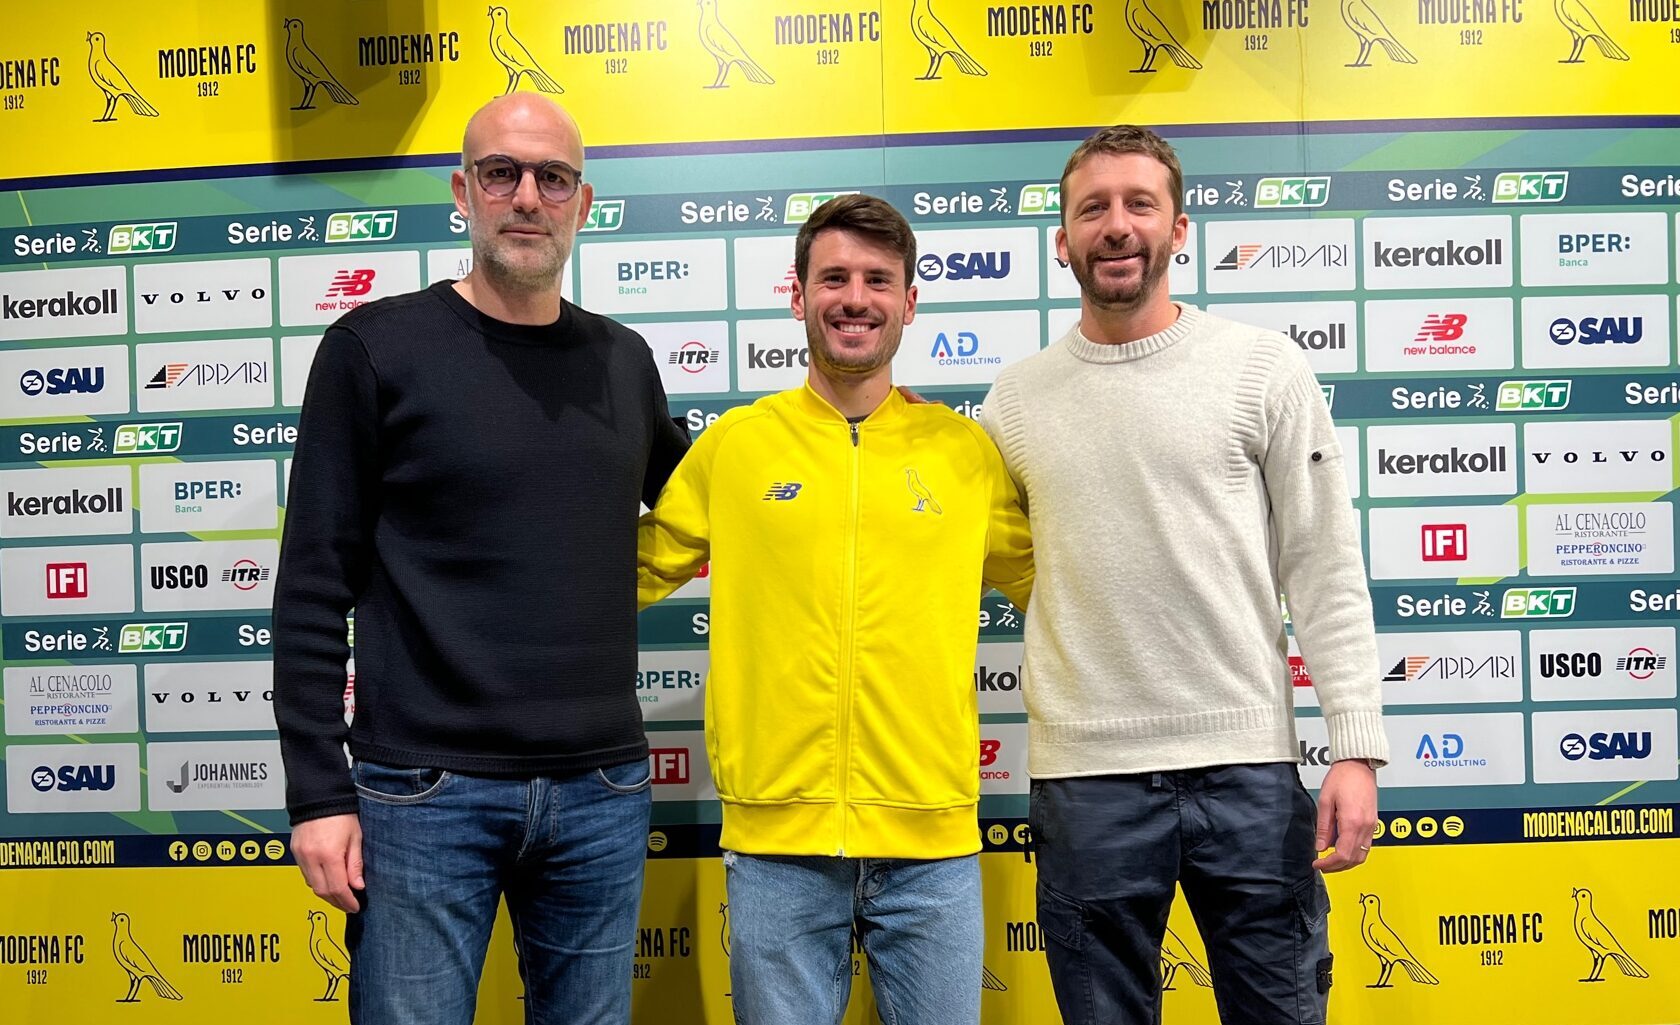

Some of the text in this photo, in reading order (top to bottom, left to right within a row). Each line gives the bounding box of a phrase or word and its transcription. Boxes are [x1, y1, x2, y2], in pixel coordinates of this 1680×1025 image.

[988, 3, 1093, 37] MODENA FC
[1203, 0, 1308, 30] MODENA FC
[1418, 0, 1522, 24] MODENA FC
[1630, 0, 1680, 22] MODE
[564, 21, 667, 54] MODENA FC
[775, 11, 879, 45] MODENA FC
[1460, 29, 1483, 46] 1912
[358, 31, 459, 66] MODENA FC
[1029, 41, 1053, 57] 1912
[1245, 35, 1268, 51] 1912
[158, 44, 256, 78] MODENA FC
[605, 58, 628, 74] 1912
[816, 49, 839, 65] 1912
[0, 57, 60, 88] DENA FC
[398, 69, 421, 85] 1912
[197, 81, 219, 97] 1912
[4, 94, 24, 110] 1912
[913, 185, 1060, 215] Serie BK
[1185, 182, 1326, 206] rie BKT
[1387, 177, 1564, 202] Serie BKT
[680, 201, 749, 224] Serie
[14, 227, 174, 256] Serie BKT
[227, 215, 395, 244] Serie BKT
[1249, 244, 1347, 269] APPARI
[1374, 239, 1502, 267] kerakoll
[1559, 258, 1589, 267] Banca
[945, 251, 1010, 281] SAU
[141, 288, 265, 305] VOLVO
[618, 286, 647, 295] Banca
[3, 288, 118, 319] kerakoll
[315, 302, 337, 311] new
[1289, 323, 1346, 350] koll
[1578, 317, 1643, 345] SAU
[678, 350, 710, 365] ITR
[938, 357, 1002, 366] CONSULTING
[1404, 344, 1477, 356] new balance
[46, 366, 104, 395] SAU
[177, 361, 267, 387] APPARI
[1391, 385, 1567, 410] Serie BKT
[1625, 382, 1680, 405] Seri
[20, 426, 179, 454] Serie BKT
[233, 422, 298, 445] Serie
[1378, 446, 1506, 475] kerakoll
[1532, 450, 1665, 464] VOLVO
[8, 487, 122, 516] kerakoll
[175, 504, 202, 514] Banca
[1555, 512, 1646, 531] AL CENACOLO
[1423, 528, 1465, 558] IFI
[1574, 530, 1629, 538] RISTORANTE
[1556, 543, 1642, 554] PEPPERONCINO
[1561, 558, 1607, 566] RISTORANTE
[48, 566, 85, 596] IFI
[150, 564, 208, 590] USCO
[230, 568, 261, 582] ITR
[1396, 592, 1573, 617] Serie BKT
[1630, 589, 1680, 612] Seri
[25, 627, 184, 652] Serie BKT
[1418, 656, 1515, 680] APPARI
[1540, 652, 1602, 678] USCO
[1625, 656, 1658, 671] ITR
[29, 674, 112, 692] AL CENACOLO
[47, 691, 95, 699] RISTORANTE
[30, 704, 109, 715] PEPPERONCINO
[35, 718, 77, 726] RISTORANTE
[1588, 731, 1652, 760] SAU
[193, 763, 267, 781] JOHANNES
[1424, 758, 1487, 768] CONSULTING
[57, 764, 115, 791] SAU
[1523, 808, 1673, 838] MODENACALCIO.COM
[1, 840, 115, 866] DENACALCIO.COM
[1439, 912, 1543, 945] MODENA FC
[65, 934, 84, 964] FC
[183, 933, 280, 963] MODENA FC
[670, 927, 690, 957] FC
[1480, 950, 1503, 966] 1912
[26, 969, 47, 985] 1912
[221, 968, 243, 984] 1912
[633, 964, 650, 979] 912
